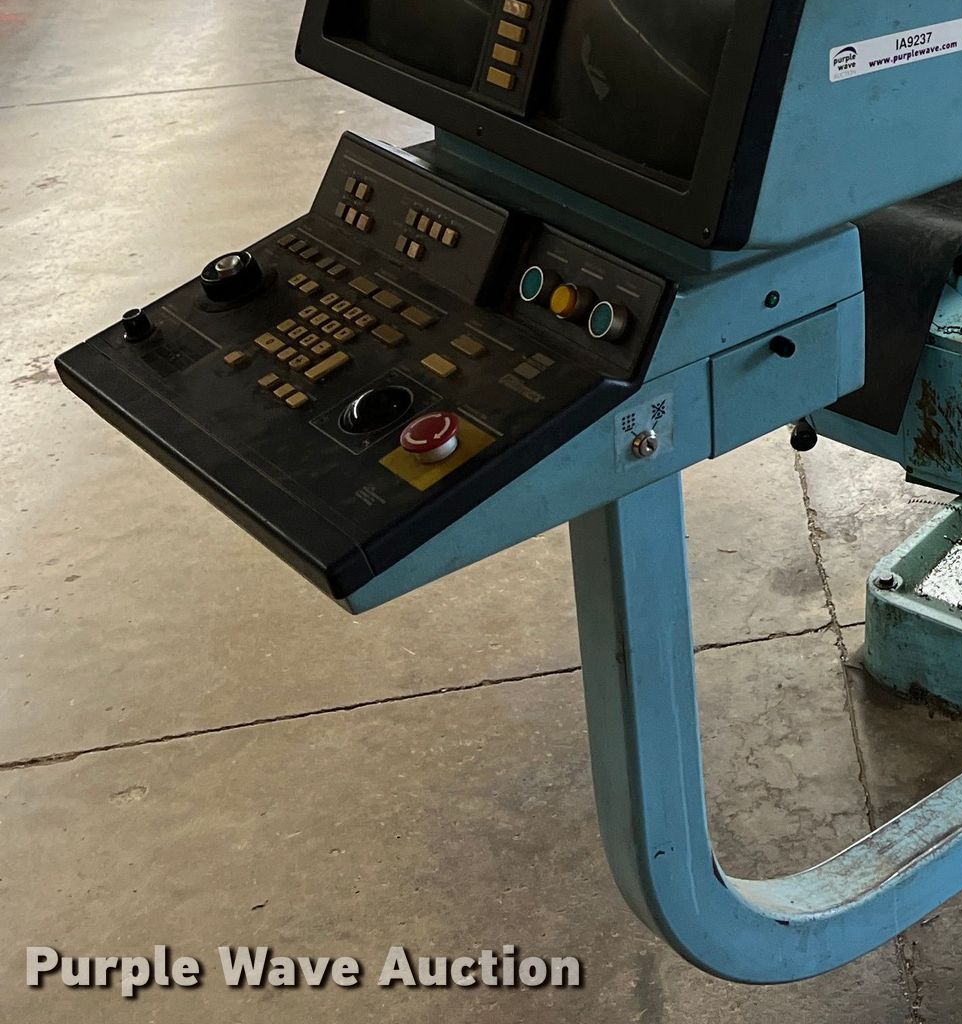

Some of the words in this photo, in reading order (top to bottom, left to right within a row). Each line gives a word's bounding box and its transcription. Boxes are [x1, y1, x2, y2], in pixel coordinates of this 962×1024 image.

[895, 31, 933, 51] IA9237
[833, 53, 857, 67] purple
[868, 41, 958, 68] www.purplewave.com
[837, 62, 857, 71] wave
